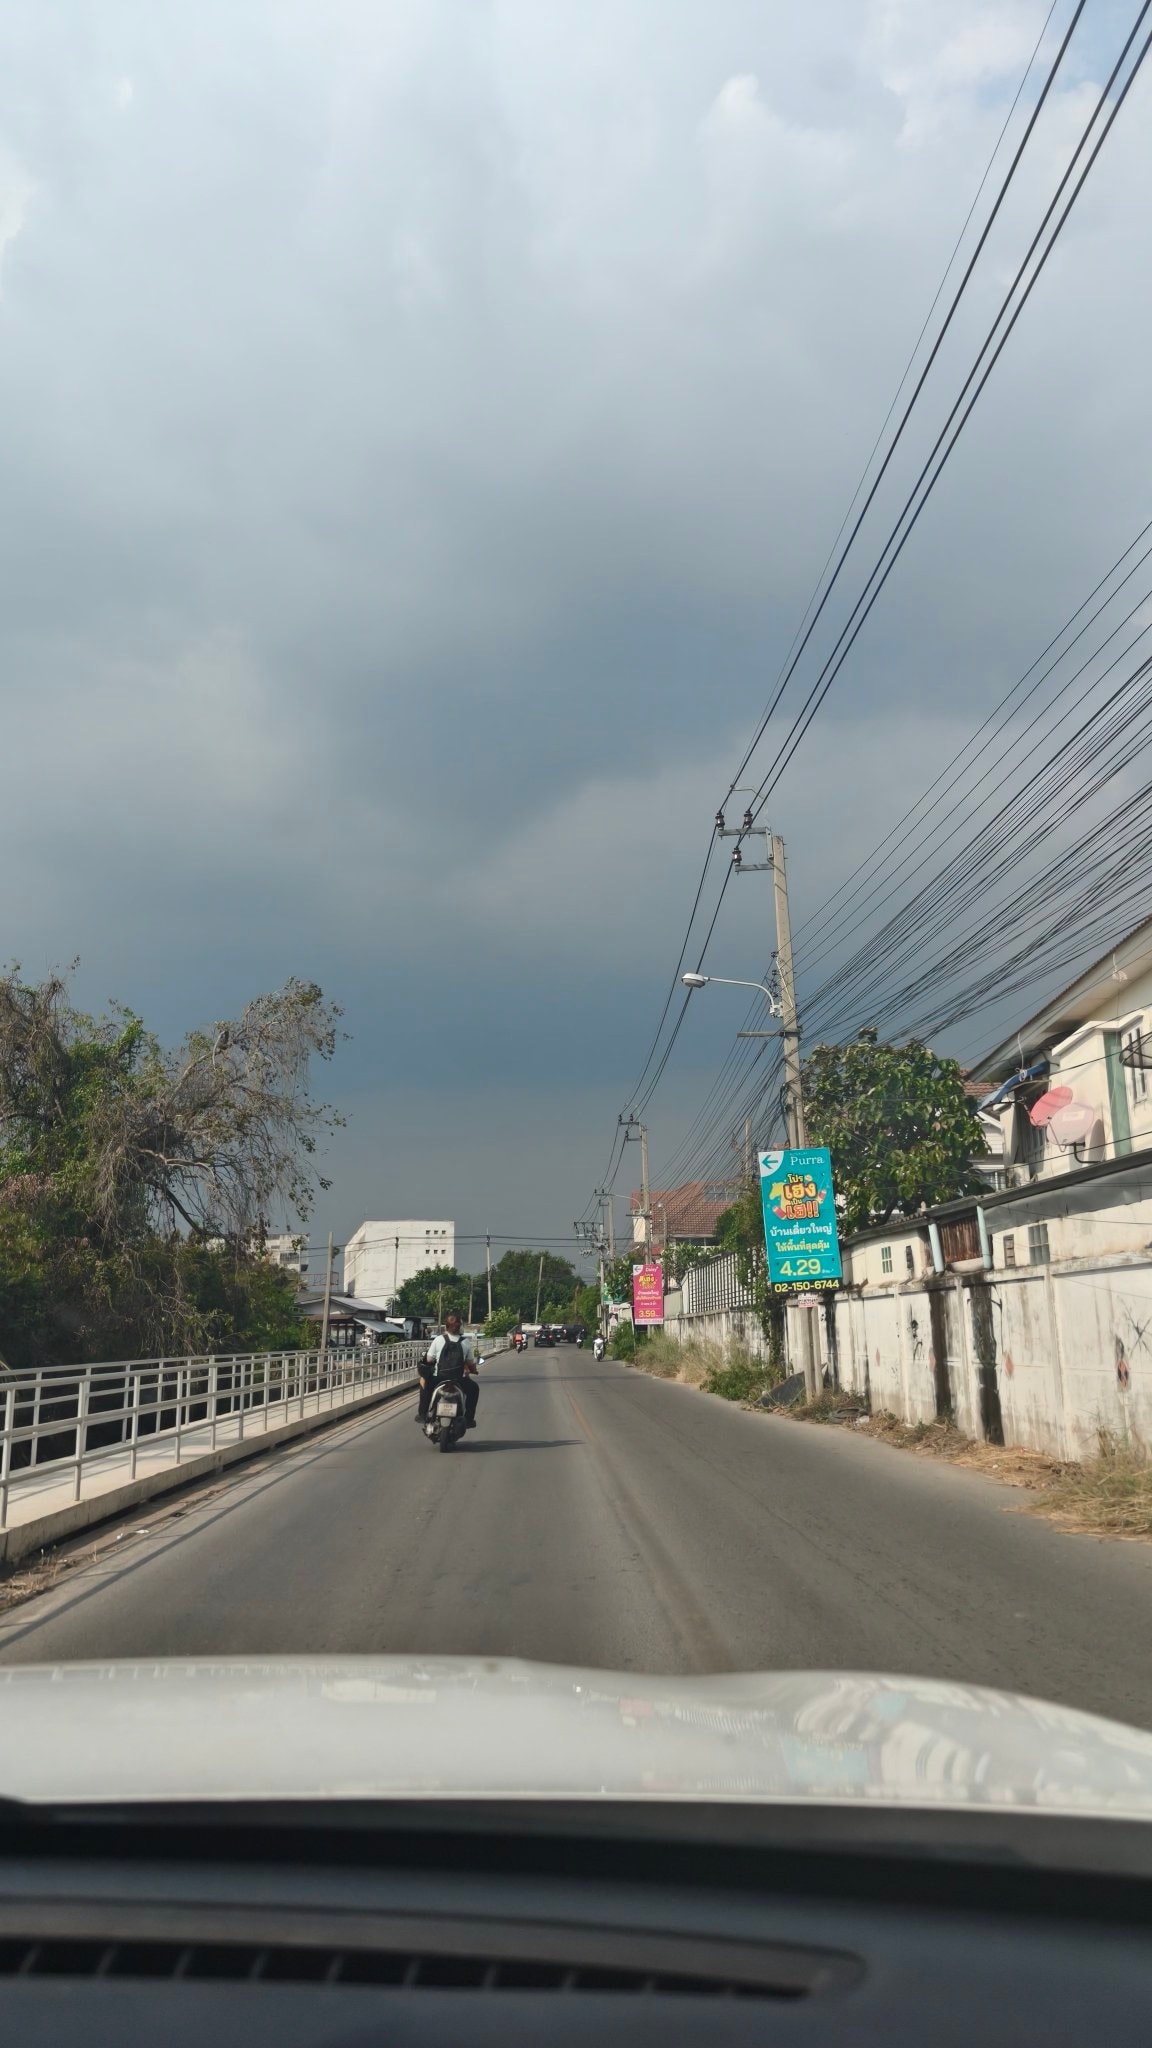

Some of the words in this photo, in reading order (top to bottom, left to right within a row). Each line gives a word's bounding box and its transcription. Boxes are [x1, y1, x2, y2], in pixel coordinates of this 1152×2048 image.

[790, 1156, 824, 1166] Purra
[787, 1173, 804, 1183] โปร
[784, 1182, 816, 1200] เฮง
[770, 1222, 832, 1237] บ้านเดี่ยวใหญ่
[780, 1259, 821, 1276] 4.29
[774, 1280, 840, 1293] 02-150-6744
